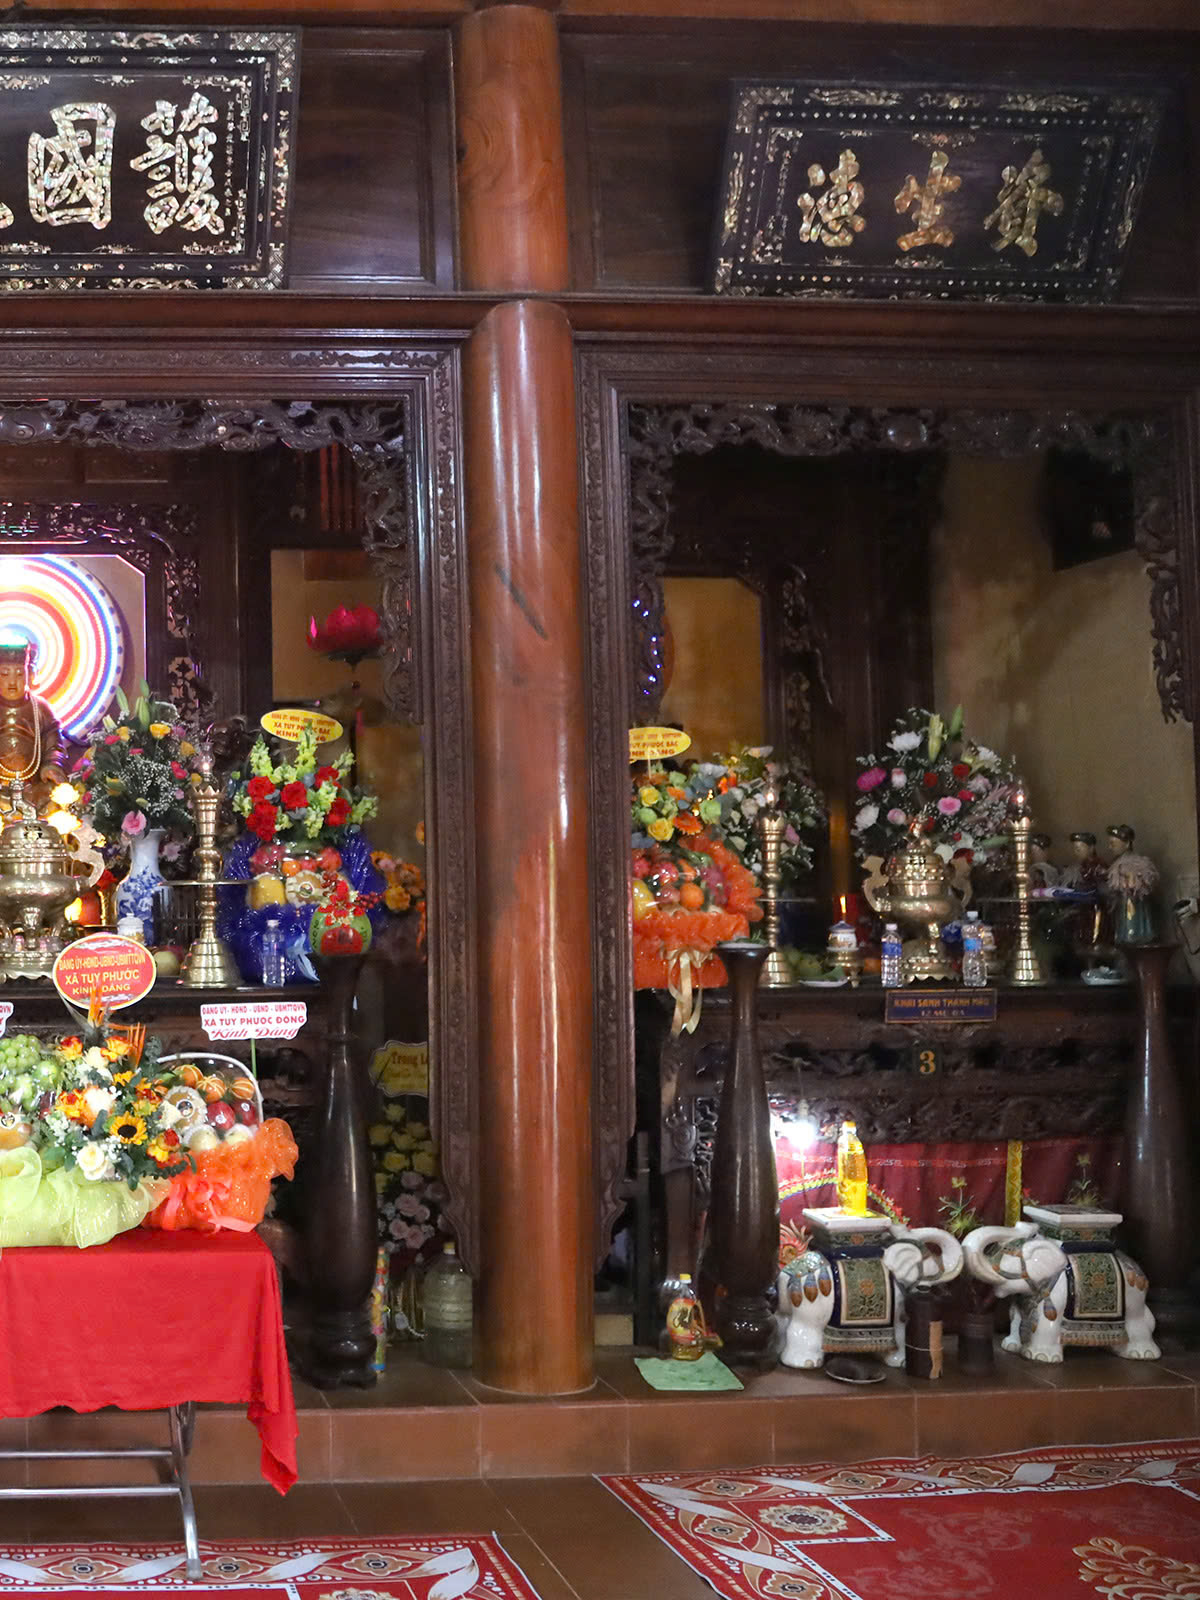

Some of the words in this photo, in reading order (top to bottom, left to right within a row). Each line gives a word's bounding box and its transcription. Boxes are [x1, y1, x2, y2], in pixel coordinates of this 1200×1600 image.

[81, 972, 100, 983] TUY
[219, 1018, 237, 1026] TUY
[920, 1050, 935, 1074] 3
